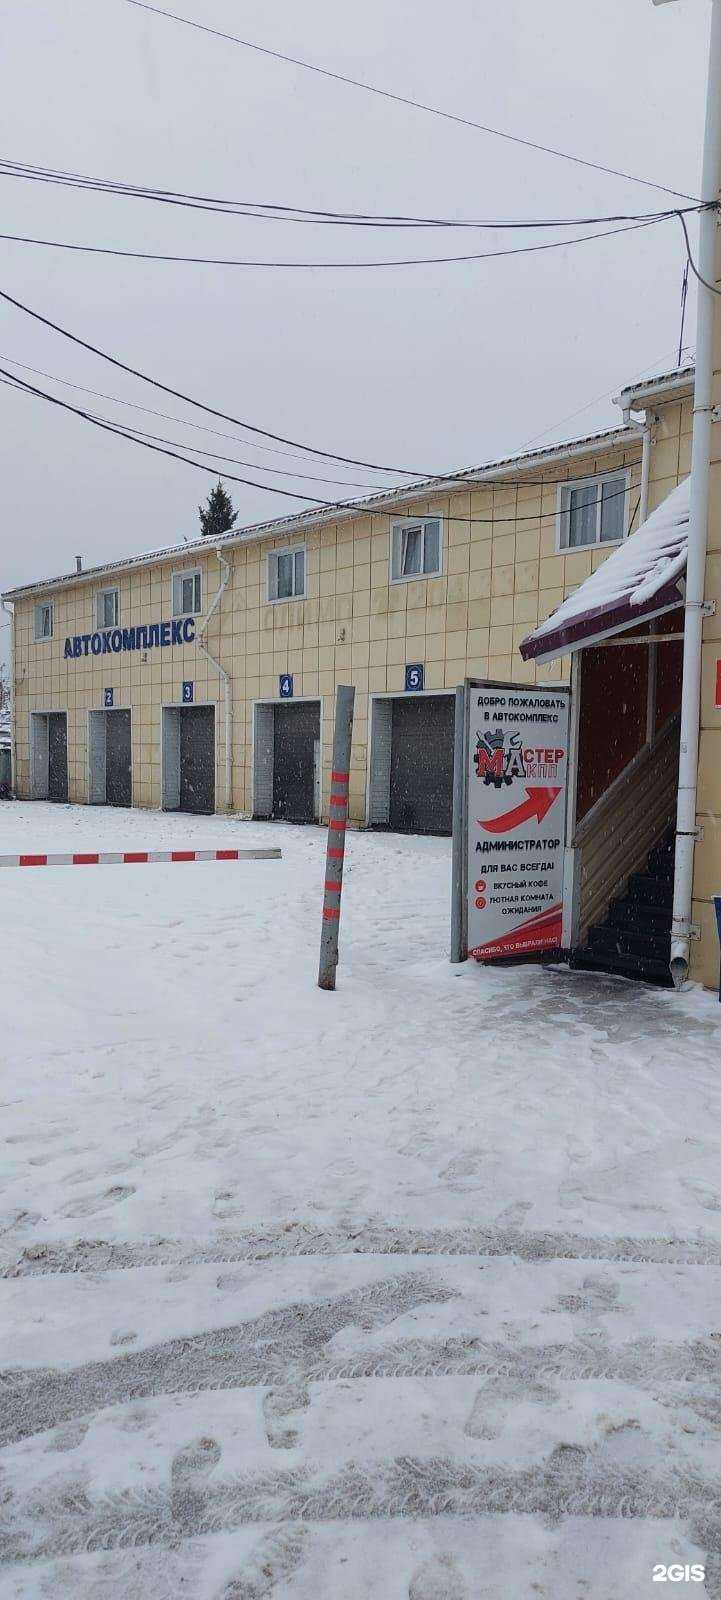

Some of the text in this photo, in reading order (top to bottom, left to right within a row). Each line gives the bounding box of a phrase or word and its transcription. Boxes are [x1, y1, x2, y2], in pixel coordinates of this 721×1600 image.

[63, 617, 195, 659] АВТОКОМПЛЕКС
[410, 671, 419, 686] 5
[185, 686, 191, 698] 3
[281, 679, 290, 693] 4
[105, 691, 112, 703] 2
[477, 696, 566, 709] ДОБРО ПОЖАЛОВАТЬ
[484, 711, 559, 723] В АВТОКОМПЛЕКС
[526, 763, 558, 778] КПП
[475, 839, 561, 853] АДМИНИСТРАТОР
[480, 862, 554, 874] ДЛЯ ВАС ВСЕГДА!
[493, 879, 548, 890] ВКУСНЫЙ КОФЕ
[520, 893, 554, 902] КОМНАТА
